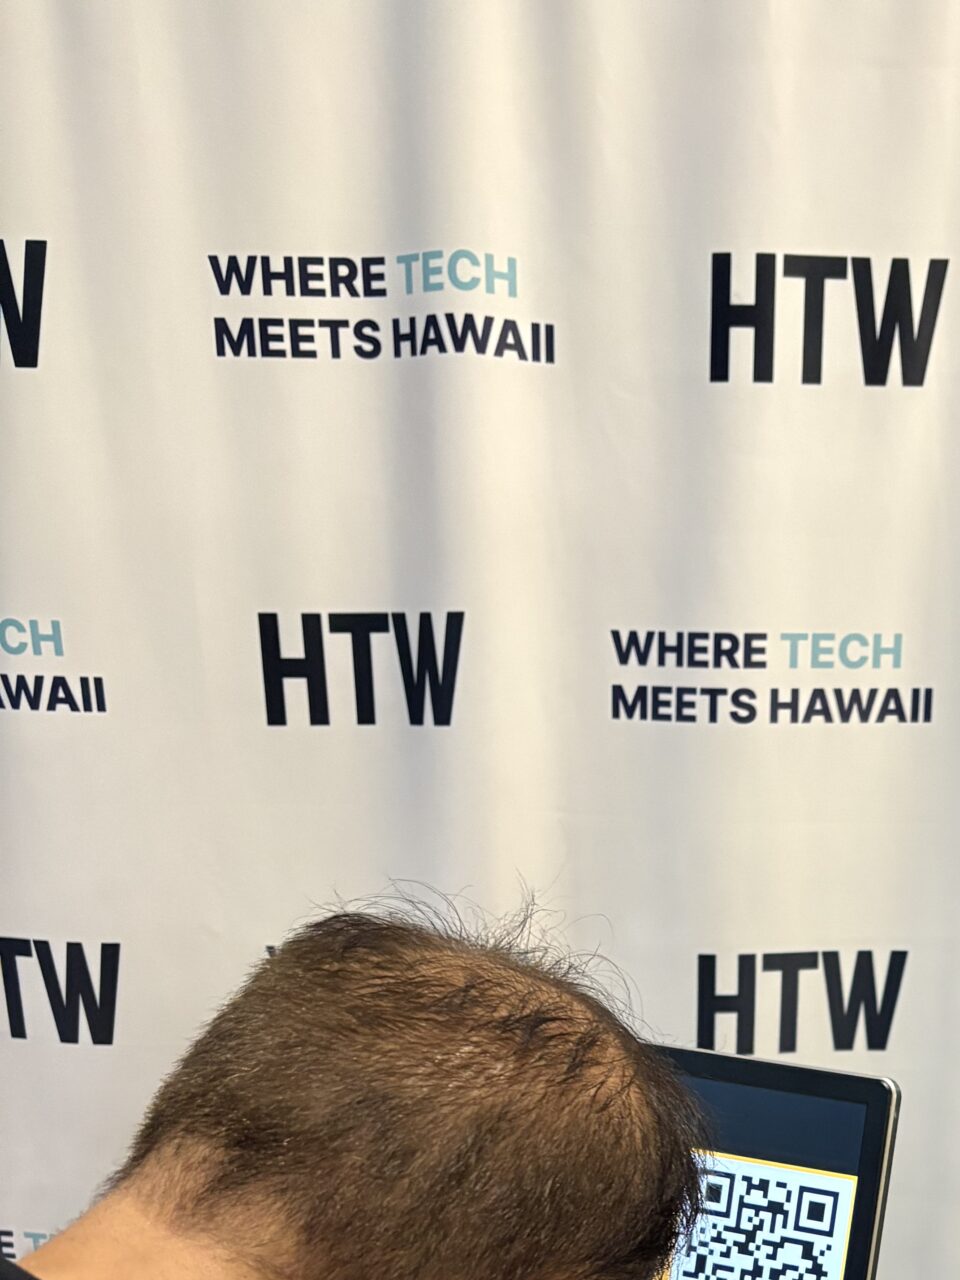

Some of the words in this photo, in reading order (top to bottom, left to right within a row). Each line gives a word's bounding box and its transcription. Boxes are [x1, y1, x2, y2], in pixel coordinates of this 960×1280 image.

[208, 254, 387, 298] WHERE
[396, 249, 519, 299] TECH
[213, 317, 383, 360] MEETS
[393, 313, 556, 365] HAWAII
[709, 251, 949, 387] HTW
[0, 618, 65, 658] CH
[611, 629, 768, 670] WHERE
[780, 631, 904, 671] TECH
[0, 673, 107, 714] WAII
[256, 611, 465, 727] HTW
[610, 684, 757, 725] MEETS
[769, 687, 934, 725] HAWAII
[0, 936, 121, 1046] TW
[695, 949, 909, 1055] HTW
